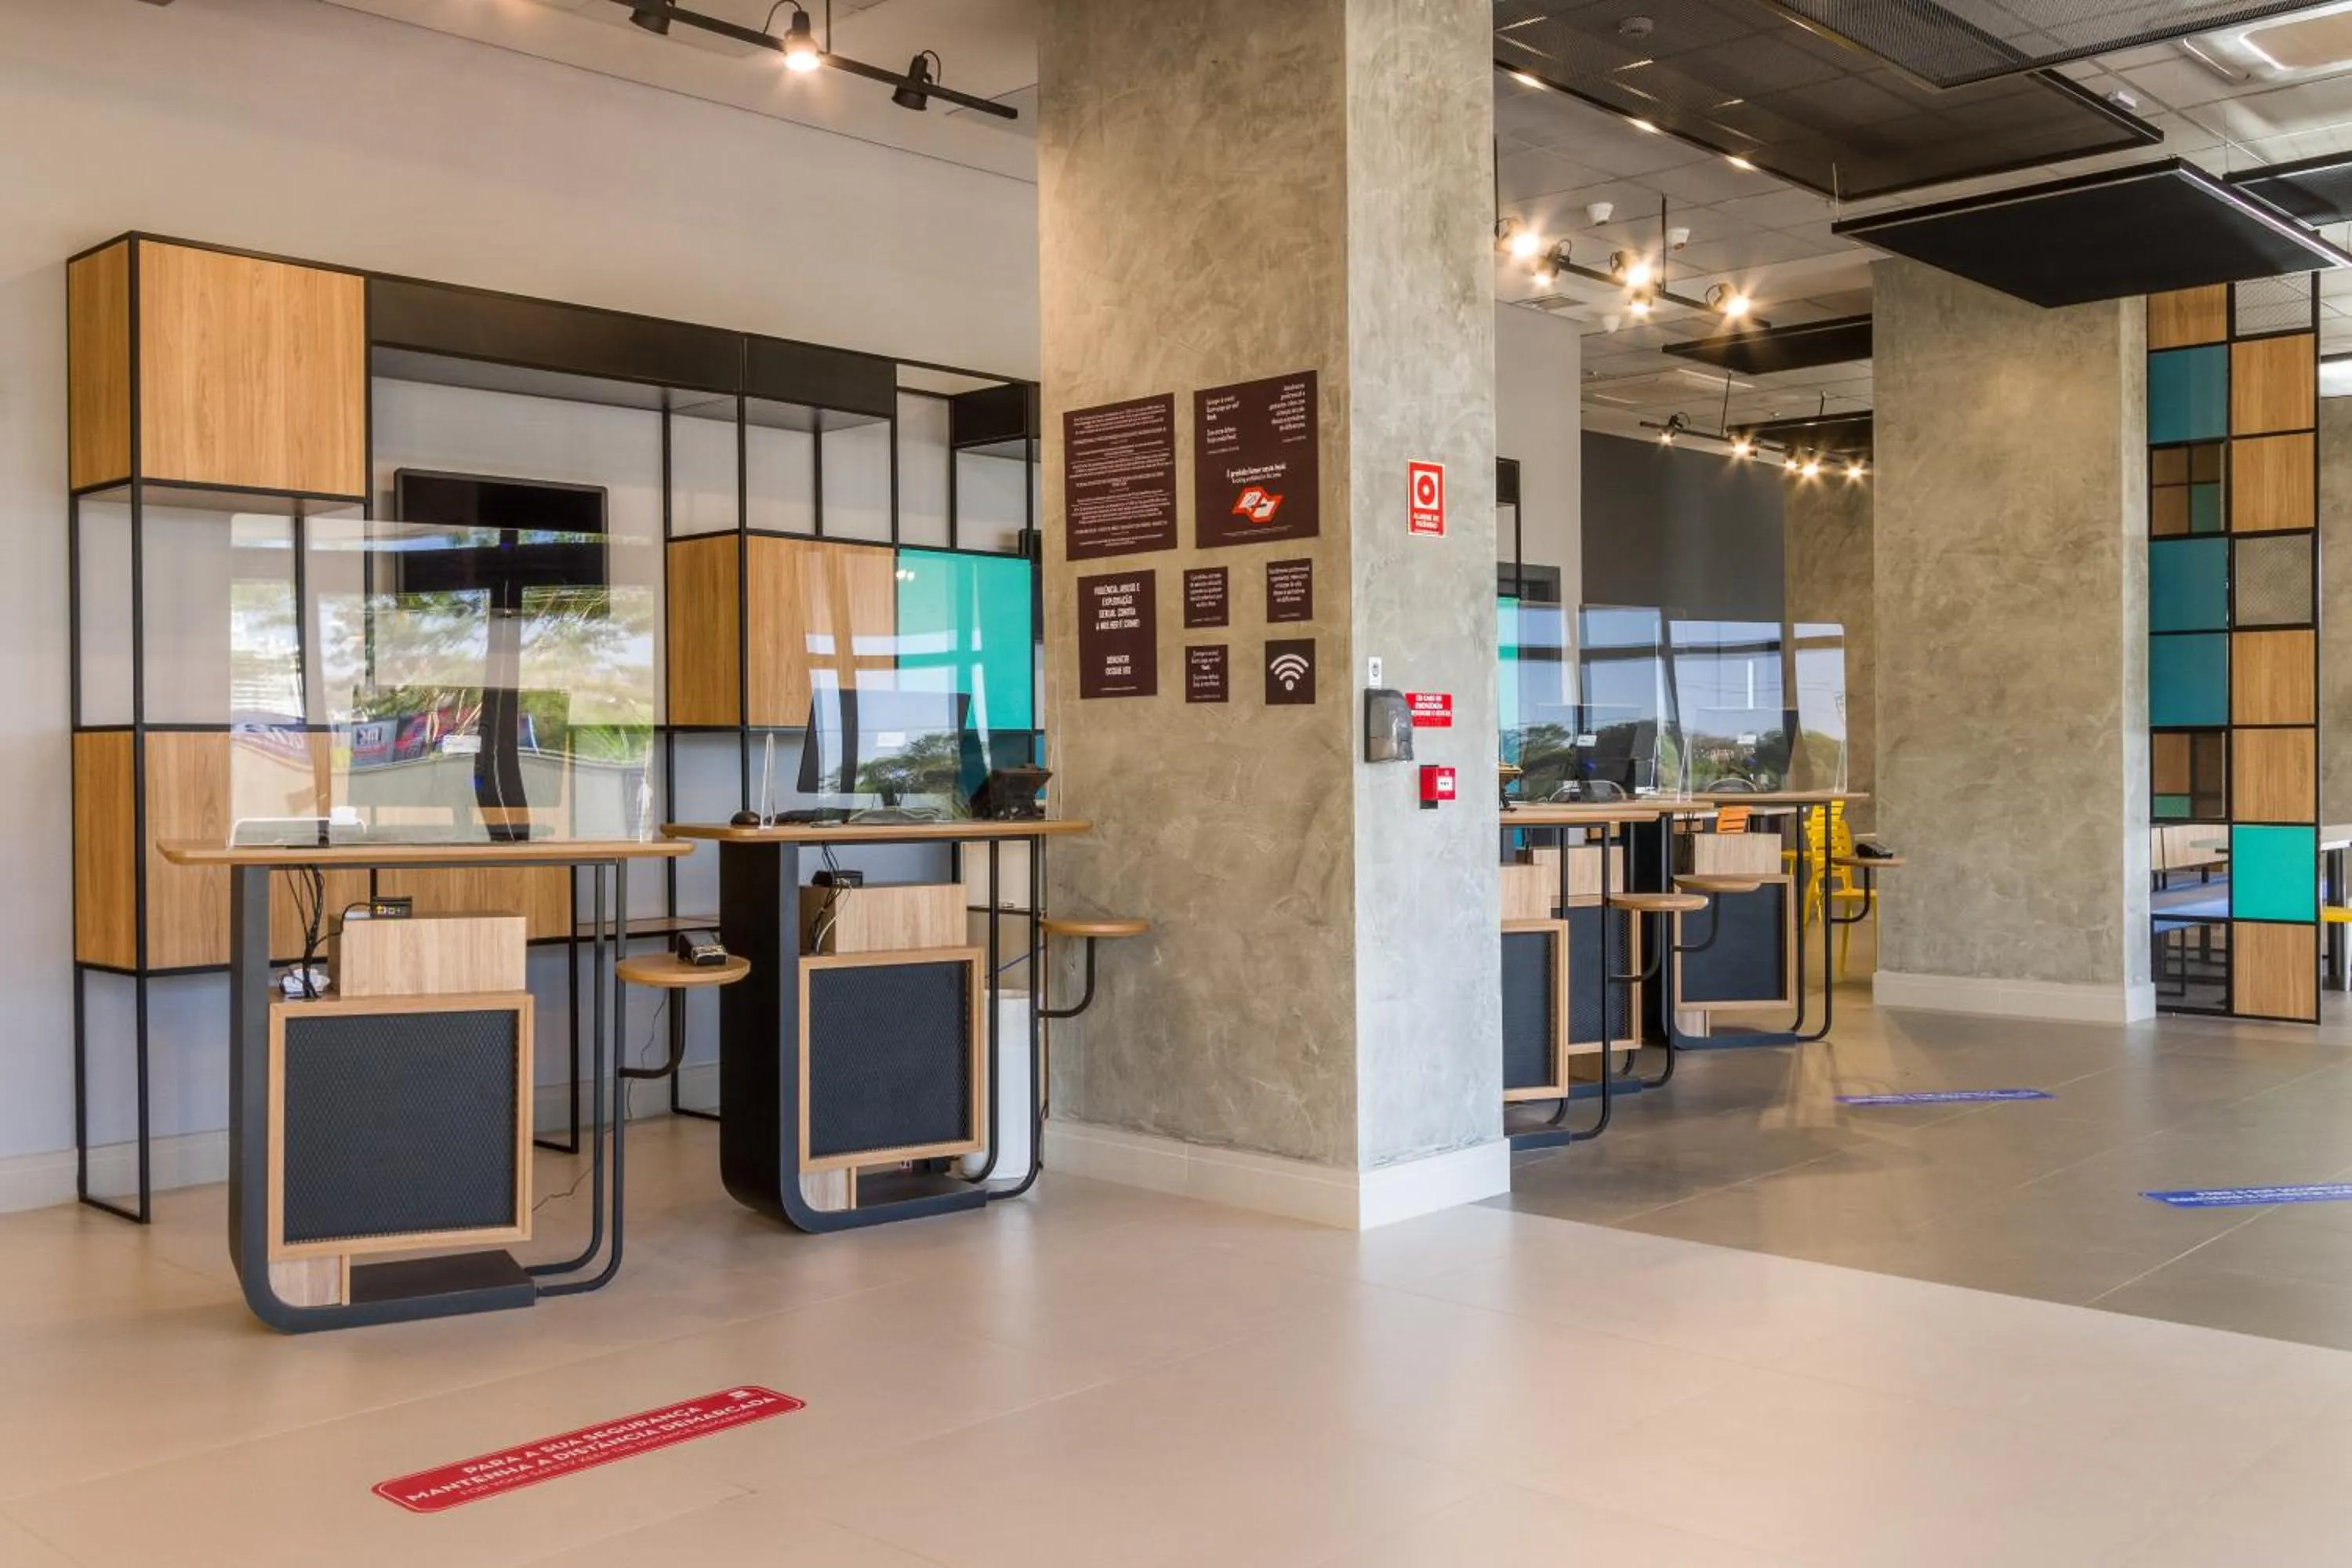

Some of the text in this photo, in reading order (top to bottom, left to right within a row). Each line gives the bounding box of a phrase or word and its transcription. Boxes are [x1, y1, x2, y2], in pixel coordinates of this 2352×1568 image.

[406, 1396, 779, 1501] MANTENHA A DISTÂNCIA DEMARCADA
[462, 1456, 521, 1474] PARA
[539, 1439, 583, 1453] SUA
[583, 1406, 703, 1442] SEGURANÇA
